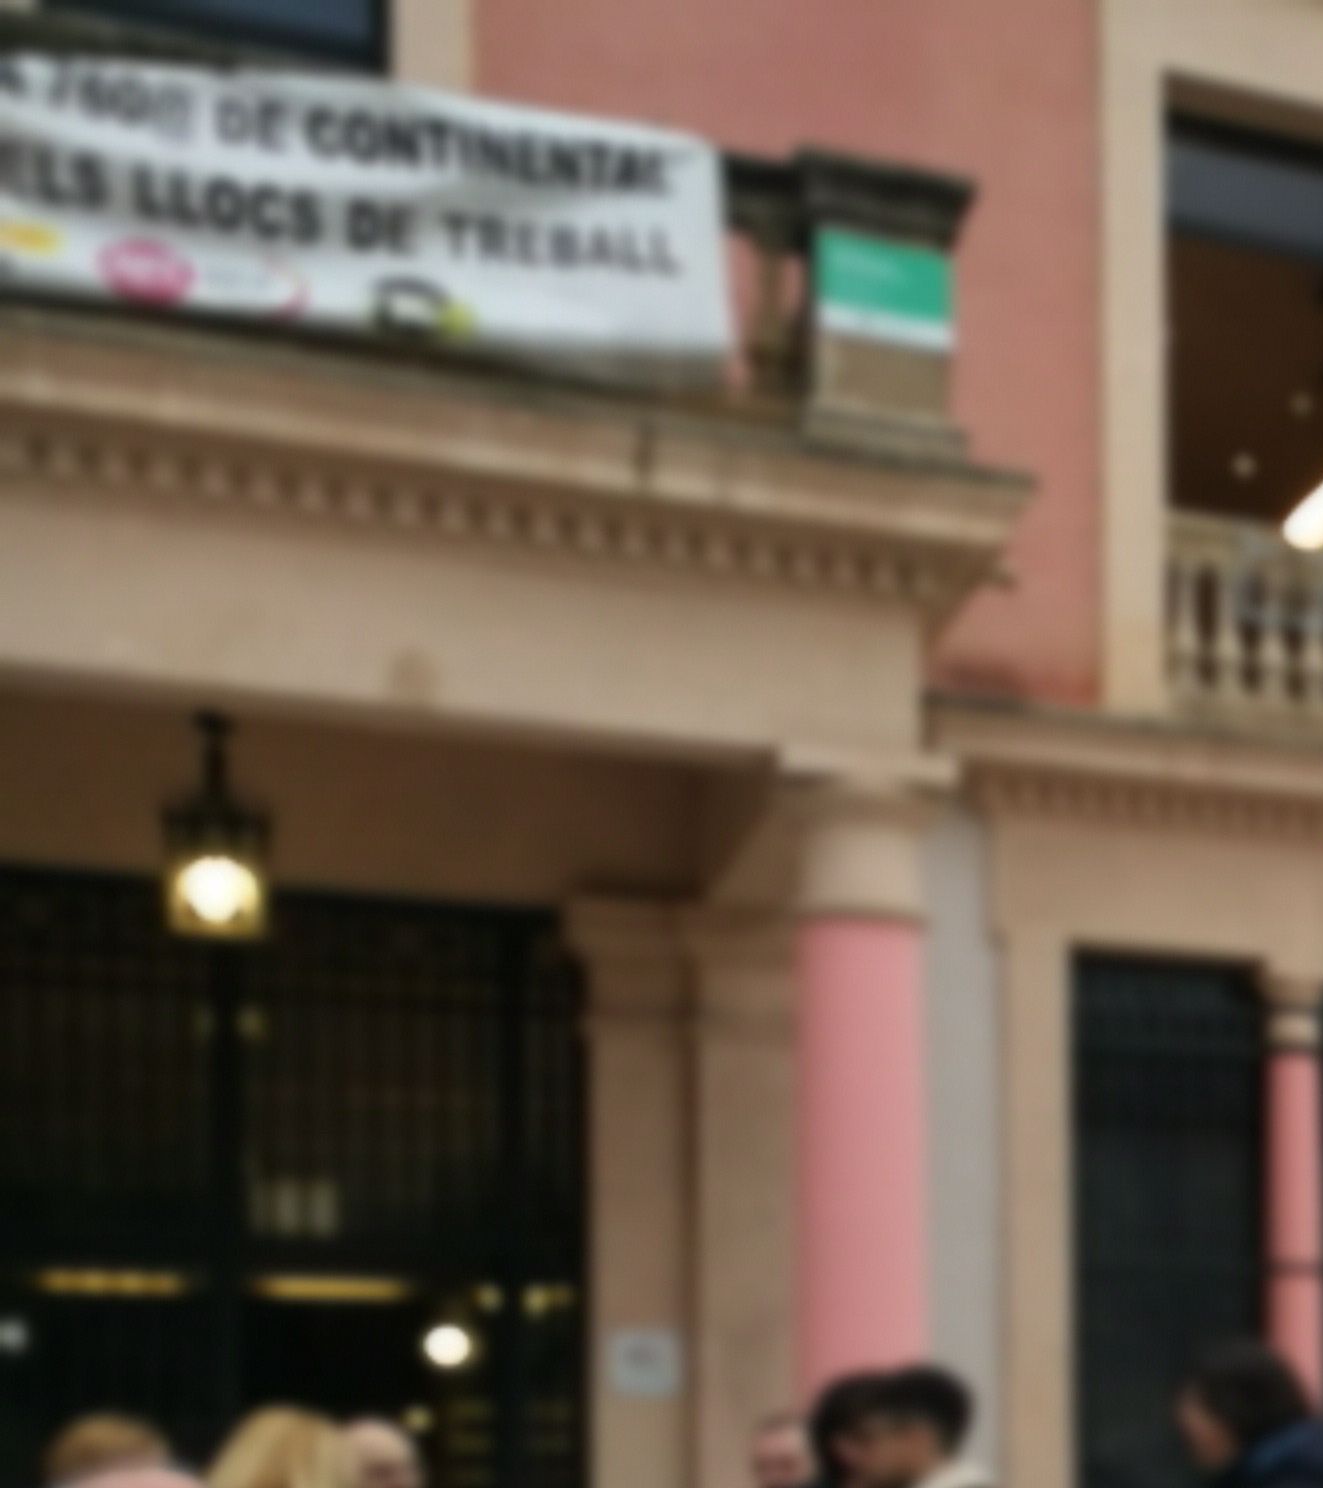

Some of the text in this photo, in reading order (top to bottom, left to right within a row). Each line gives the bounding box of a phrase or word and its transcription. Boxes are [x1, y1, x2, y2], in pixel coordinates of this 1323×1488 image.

[213, 98, 290, 156] DE
[304, 104, 670, 196] CONTINENTAL
[130, 162, 323, 248] LLOCS
[345, 196, 417, 256] DE
[443, 208, 683, 280] TREBALL
